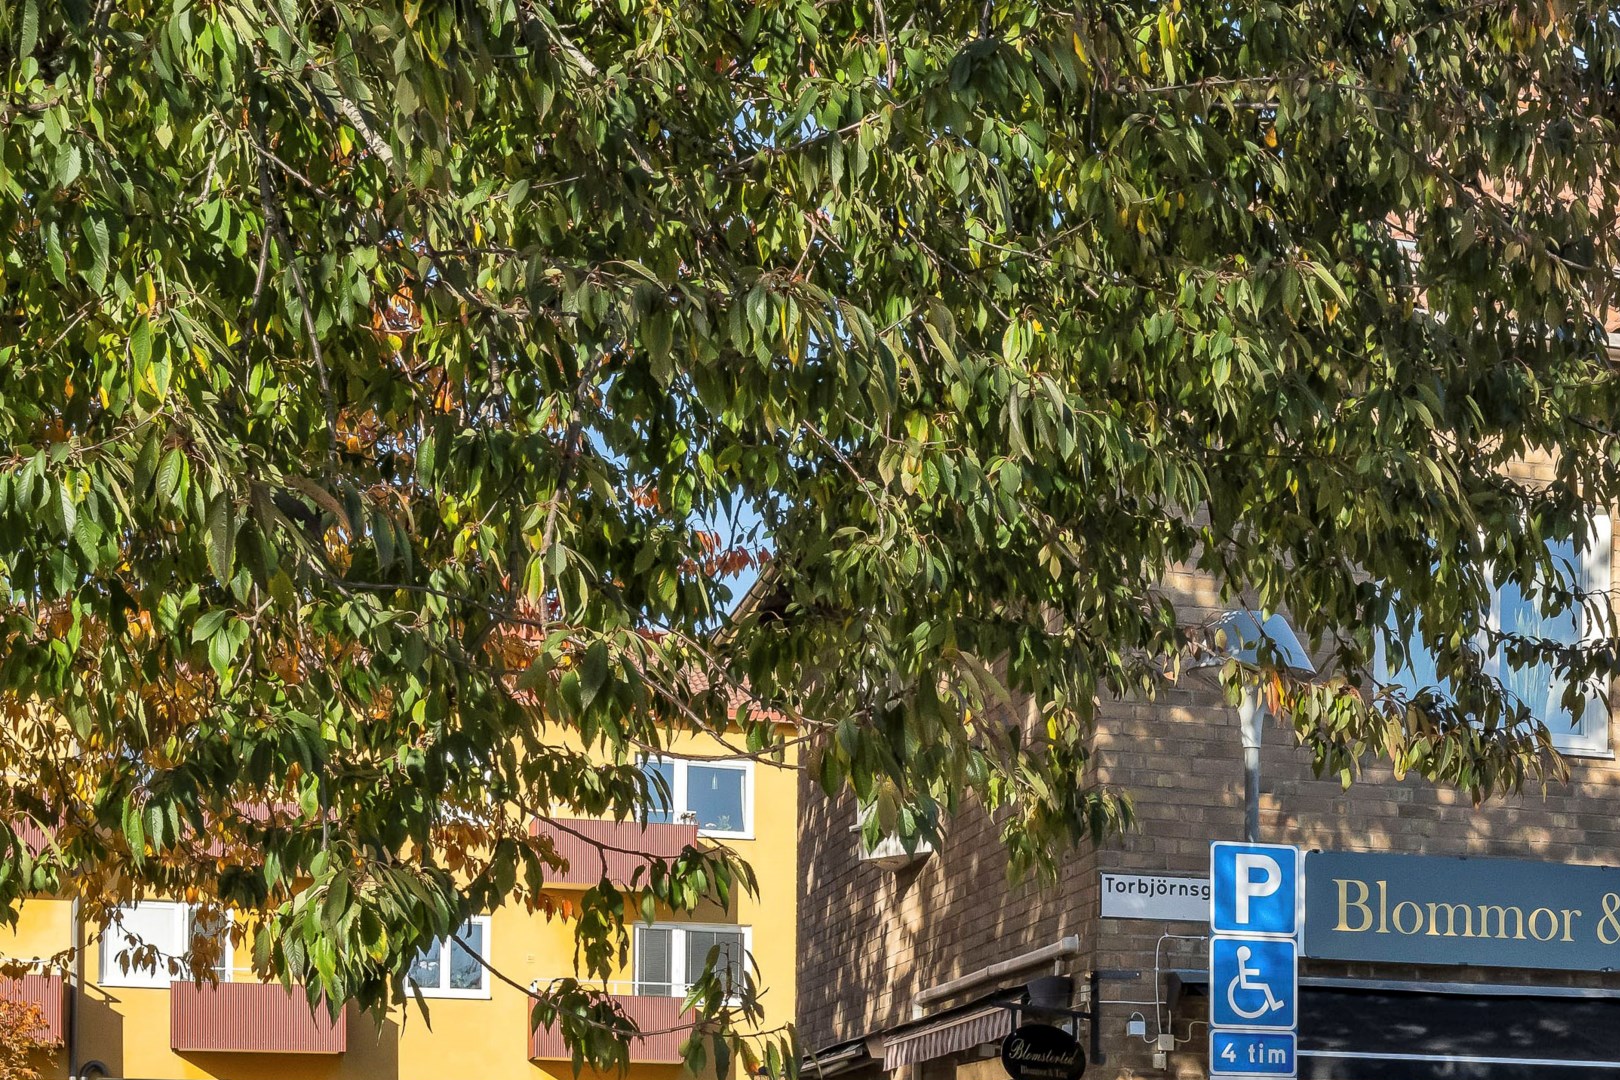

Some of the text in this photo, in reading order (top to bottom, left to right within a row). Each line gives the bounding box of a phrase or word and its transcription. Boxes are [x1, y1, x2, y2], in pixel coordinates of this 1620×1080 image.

[1235, 853, 1282, 924] P
[1331, 878, 1583, 943] Blommor
[1220, 1042, 1286, 1064] 4 tim
